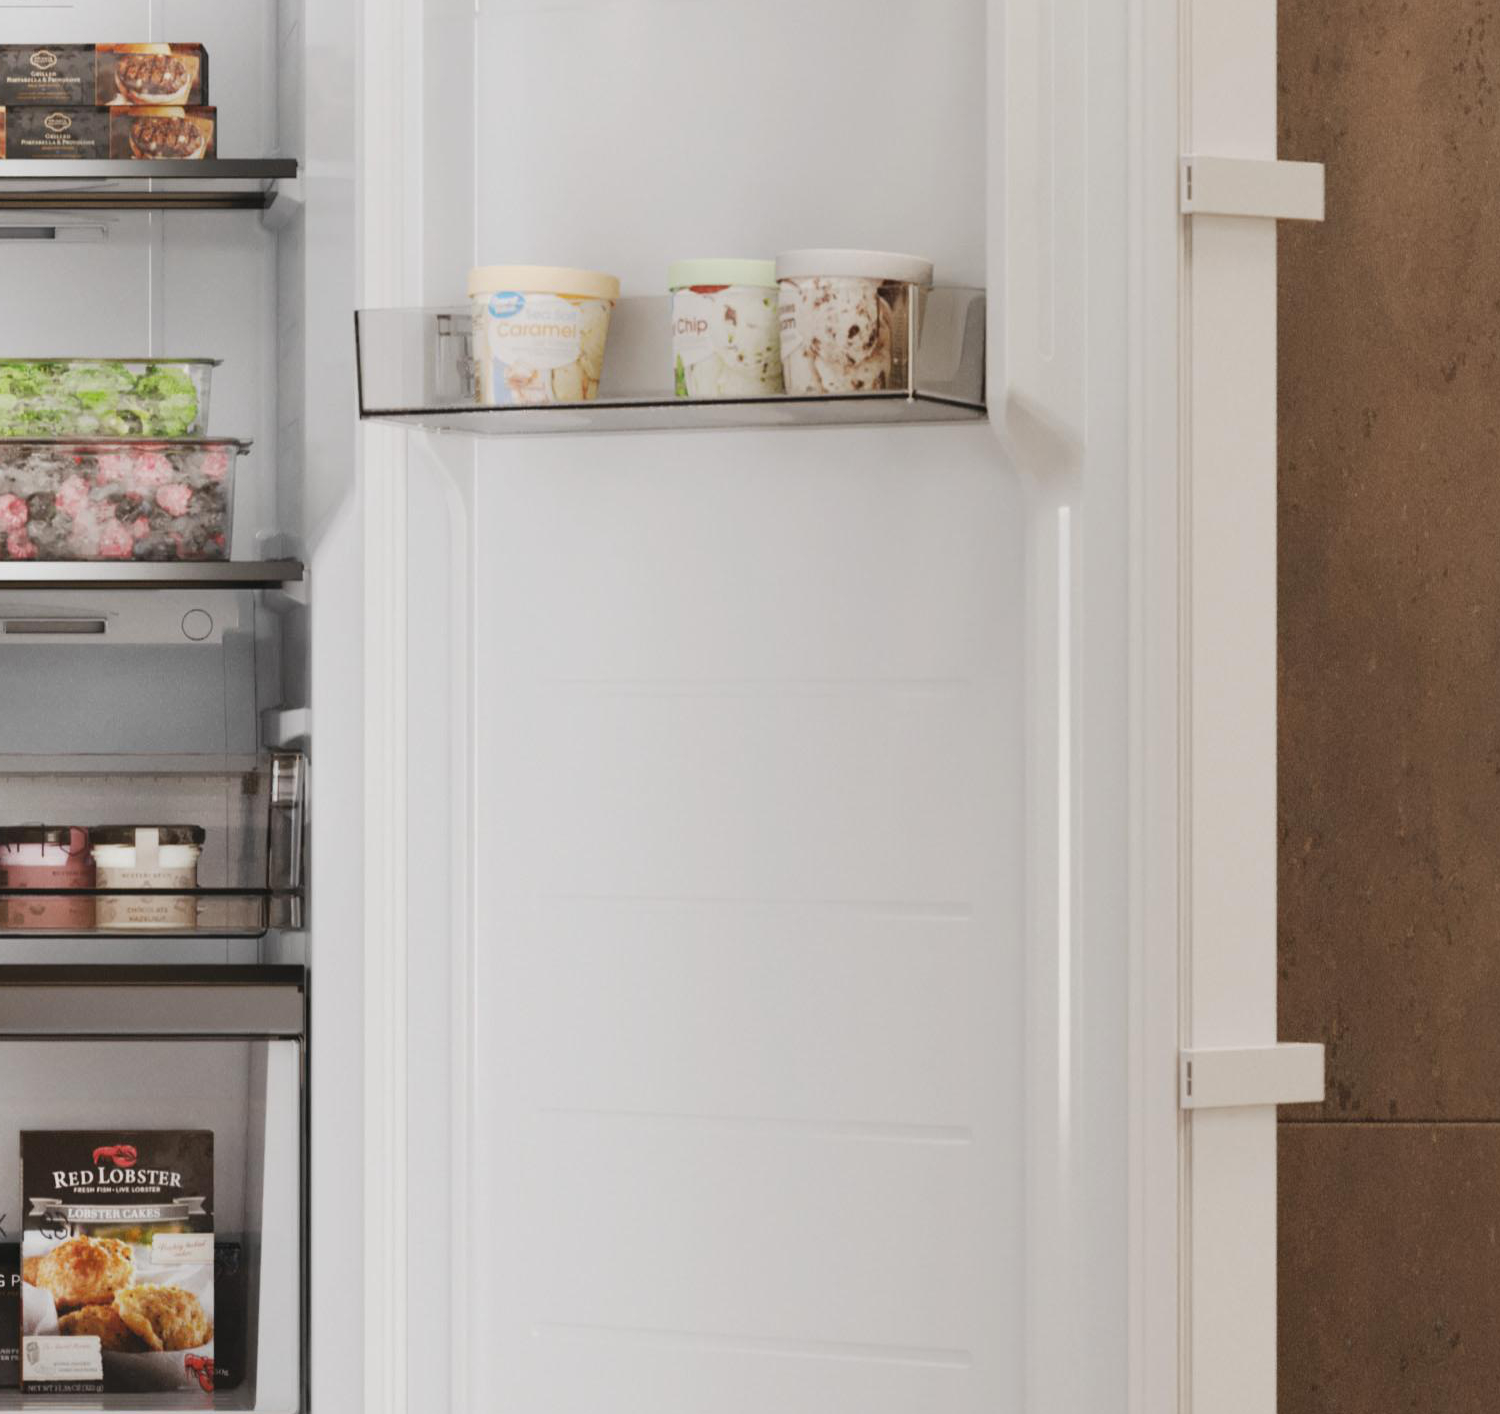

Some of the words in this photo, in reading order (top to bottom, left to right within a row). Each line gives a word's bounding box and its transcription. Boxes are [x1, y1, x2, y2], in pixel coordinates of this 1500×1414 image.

[497, 322, 576, 339] Caramel
[677, 317, 708, 336] Chip
[53, 1169, 94, 1189] RED
[97, 1166, 182, 1188] LOBSTER
[68, 1208, 121, 1219] LOBSTER
[122, 1208, 161, 1219] CAKES
